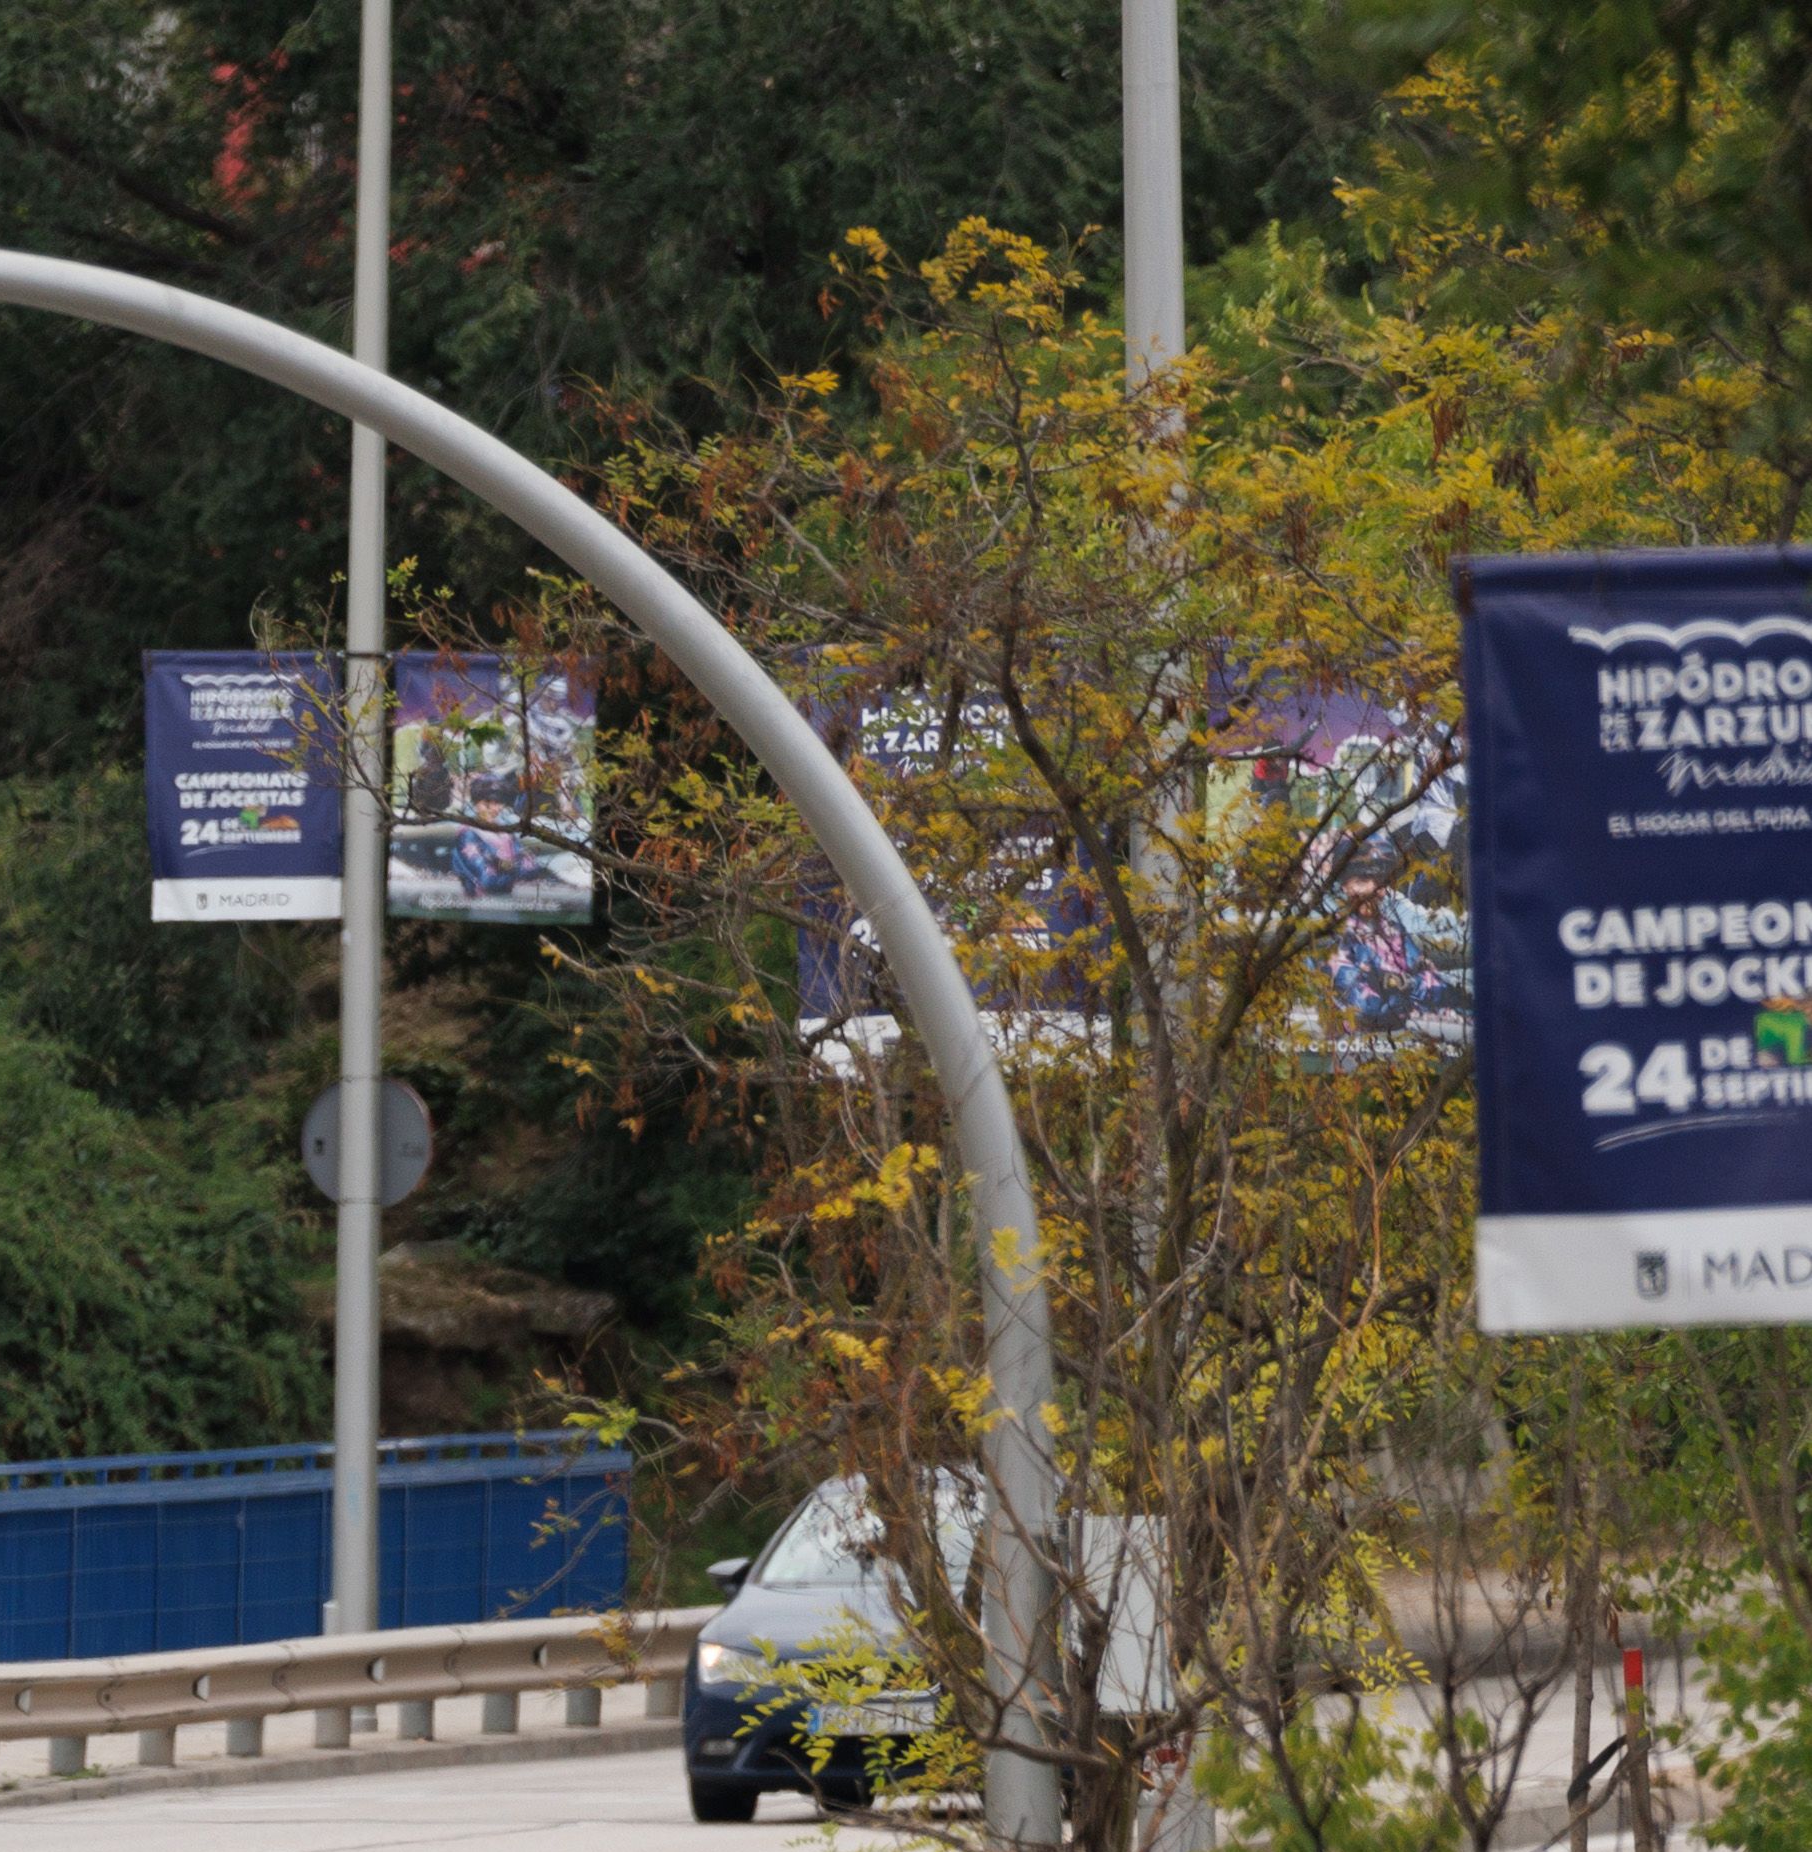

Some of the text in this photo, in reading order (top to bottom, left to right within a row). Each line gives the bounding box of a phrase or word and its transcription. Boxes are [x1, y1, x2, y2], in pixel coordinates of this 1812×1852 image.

[180, 791, 206, 808] DE
[180, 819, 219, 845] 24
[1608, 806, 1811, 838] EL HOGAR DEL PURA
[220, 894, 289, 906] MADRID
[1575, 960, 1646, 1008] DE
[1579, 1041, 1696, 1115] 24
[1701, 1036, 1752, 1070] DE
